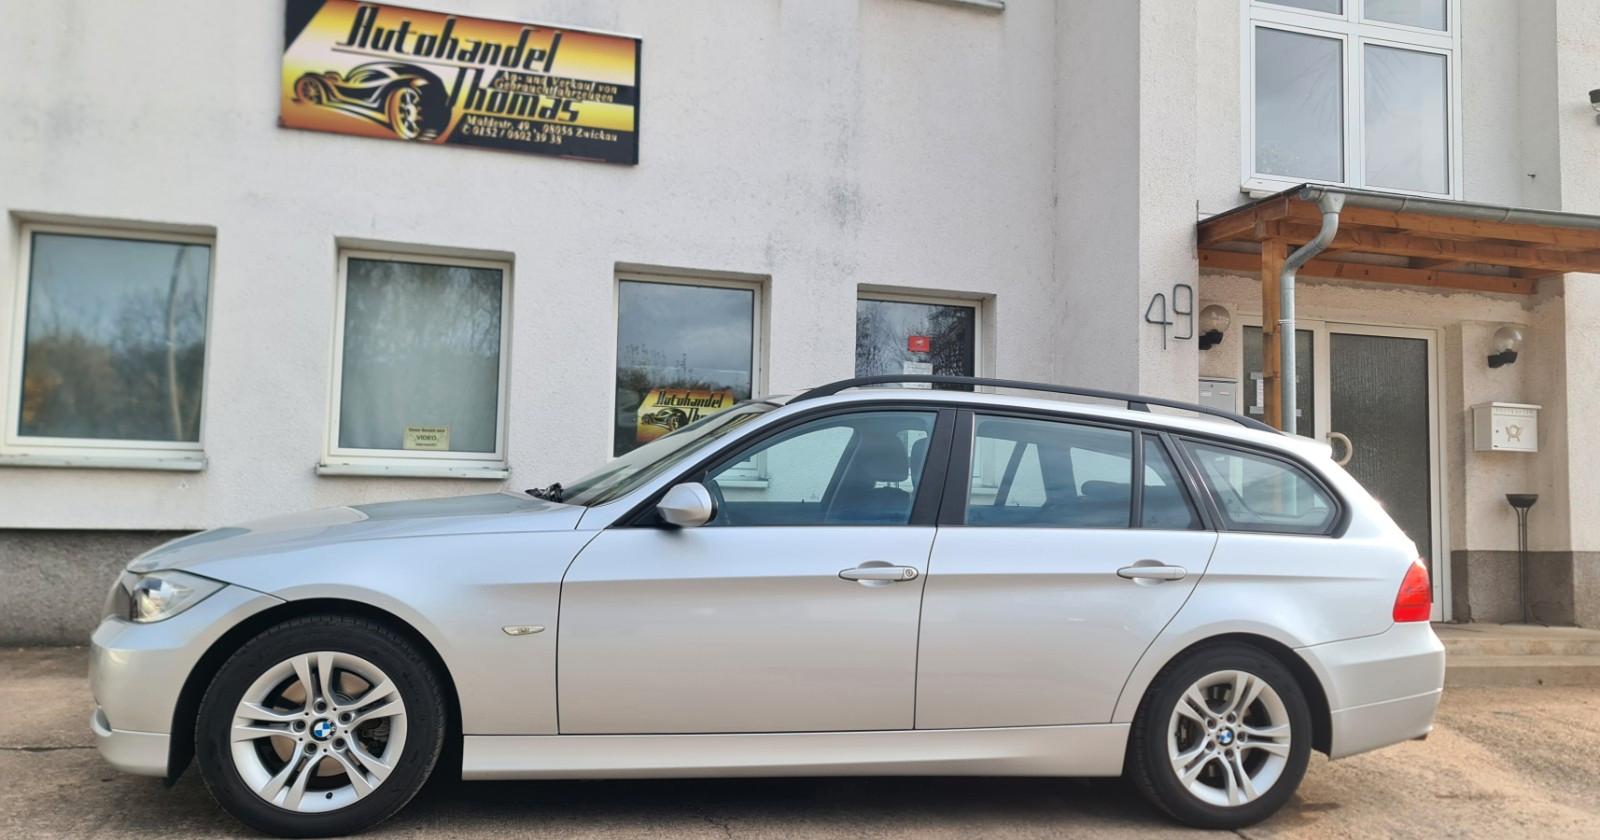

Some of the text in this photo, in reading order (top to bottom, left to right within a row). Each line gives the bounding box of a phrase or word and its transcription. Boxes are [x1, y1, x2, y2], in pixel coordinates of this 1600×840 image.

[335, 5, 562, 72] Autohandel
[450, 66, 583, 122] Thomas
[495, 77, 614, 103] Gebrauchtfahrzeugen
[526, 75, 549, 85] und
[552, 77, 595, 92] Verkauf
[598, 85, 618, 95] von
[576, 128, 618, 142] Zwickau
[1144, 283, 1193, 350] 49
[653, 390, 724, 408] Autohandel
